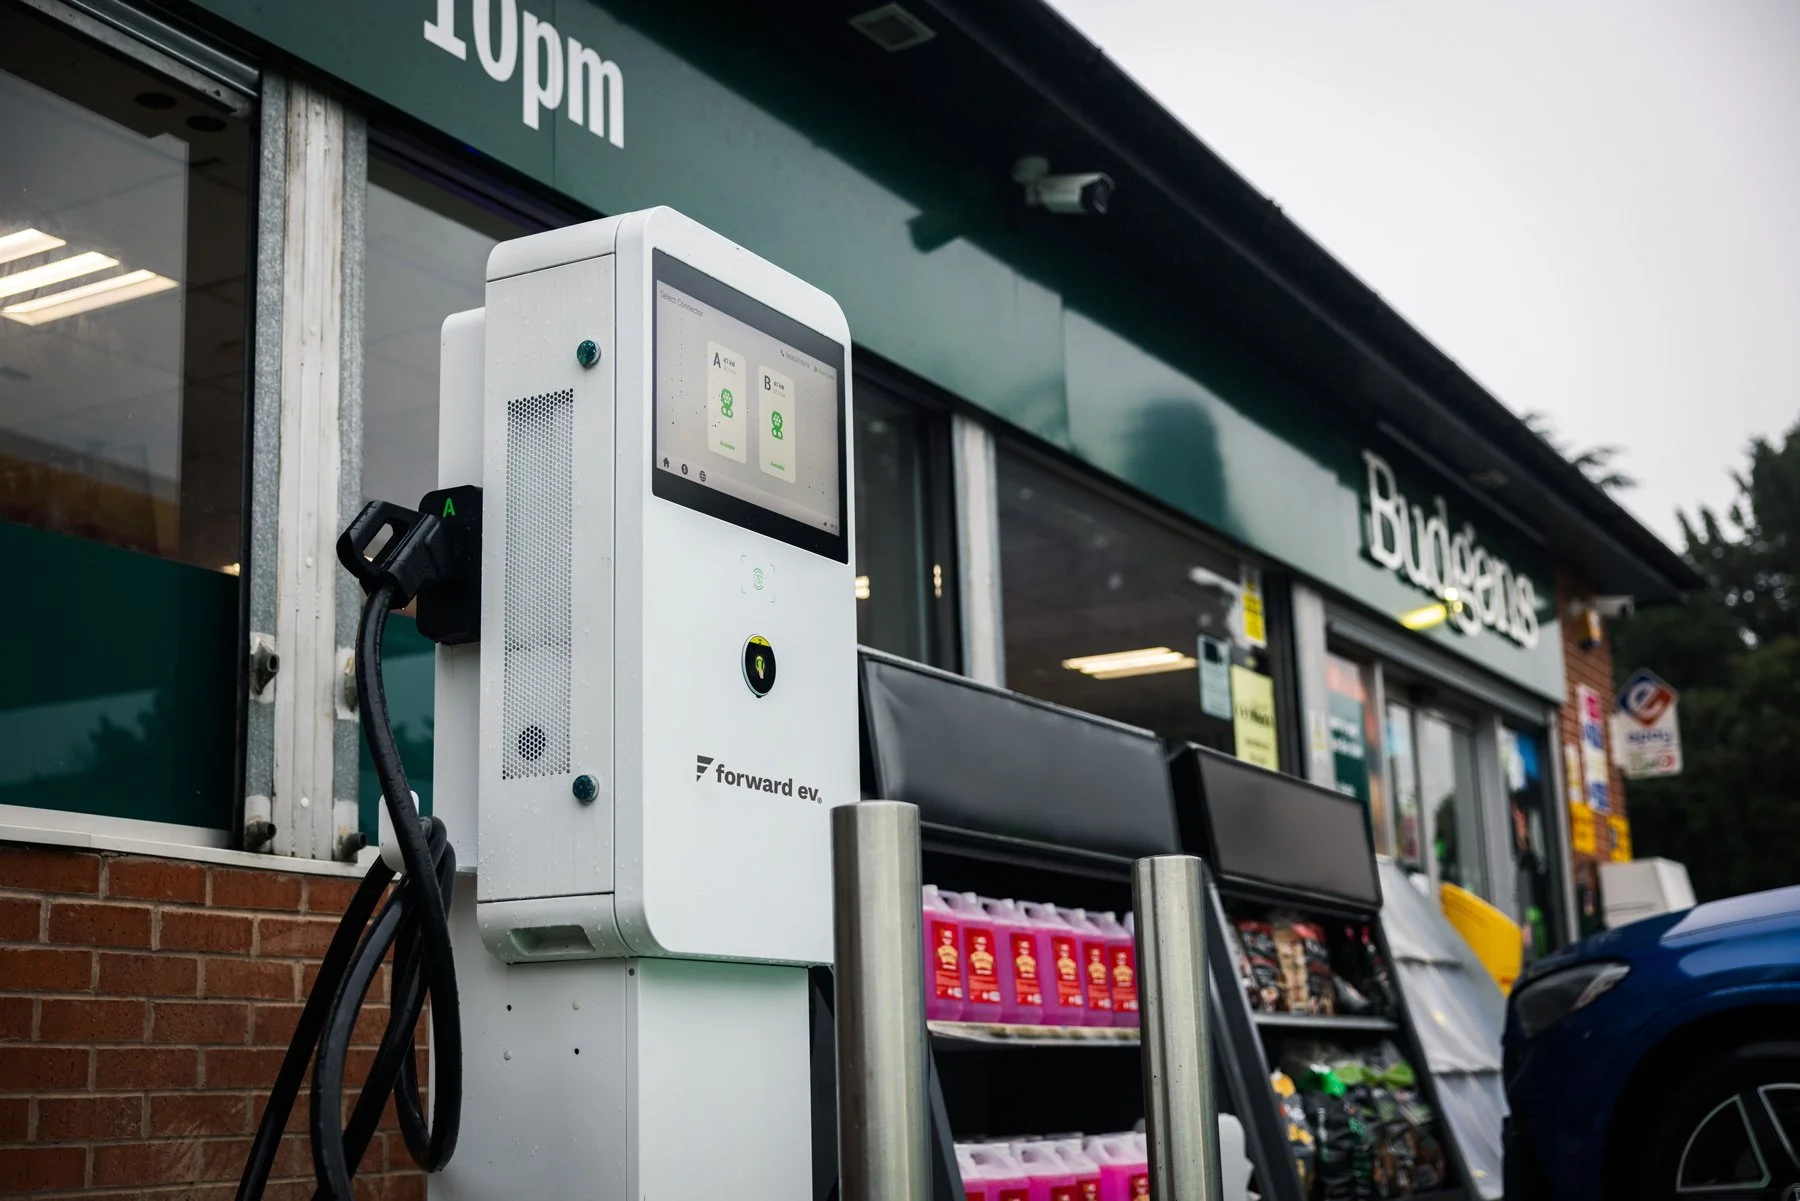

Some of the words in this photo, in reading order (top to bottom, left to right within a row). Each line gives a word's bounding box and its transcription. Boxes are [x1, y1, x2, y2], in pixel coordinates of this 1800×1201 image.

[659, 289, 676, 305] Select
[677, 298, 704, 317] Connector
[713, 352, 721, 369] A
[764, 375, 772, 391] B
[442, 497, 456, 518] A
[1362, 448, 1540, 650] Budgens
[715, 763, 793, 797] forward
